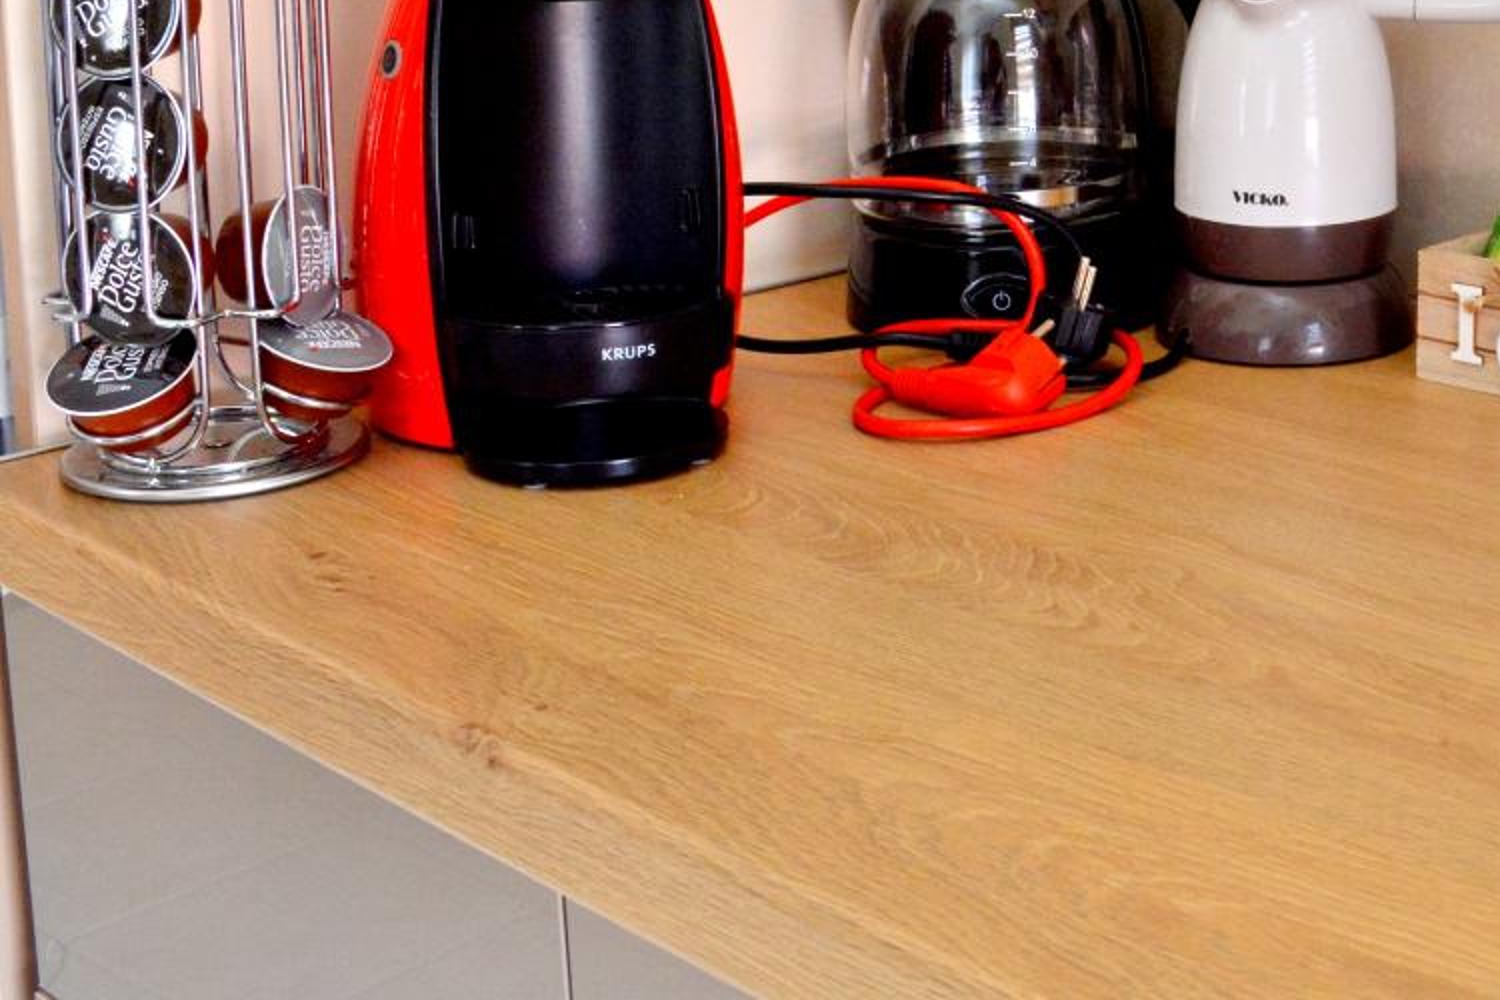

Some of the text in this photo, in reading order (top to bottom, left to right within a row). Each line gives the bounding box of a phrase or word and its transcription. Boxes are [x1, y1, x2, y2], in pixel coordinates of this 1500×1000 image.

[98, 241, 139, 308] Dolce
[601, 342, 657, 361] KRUPS
[1451, 282, 1484, 366] I
